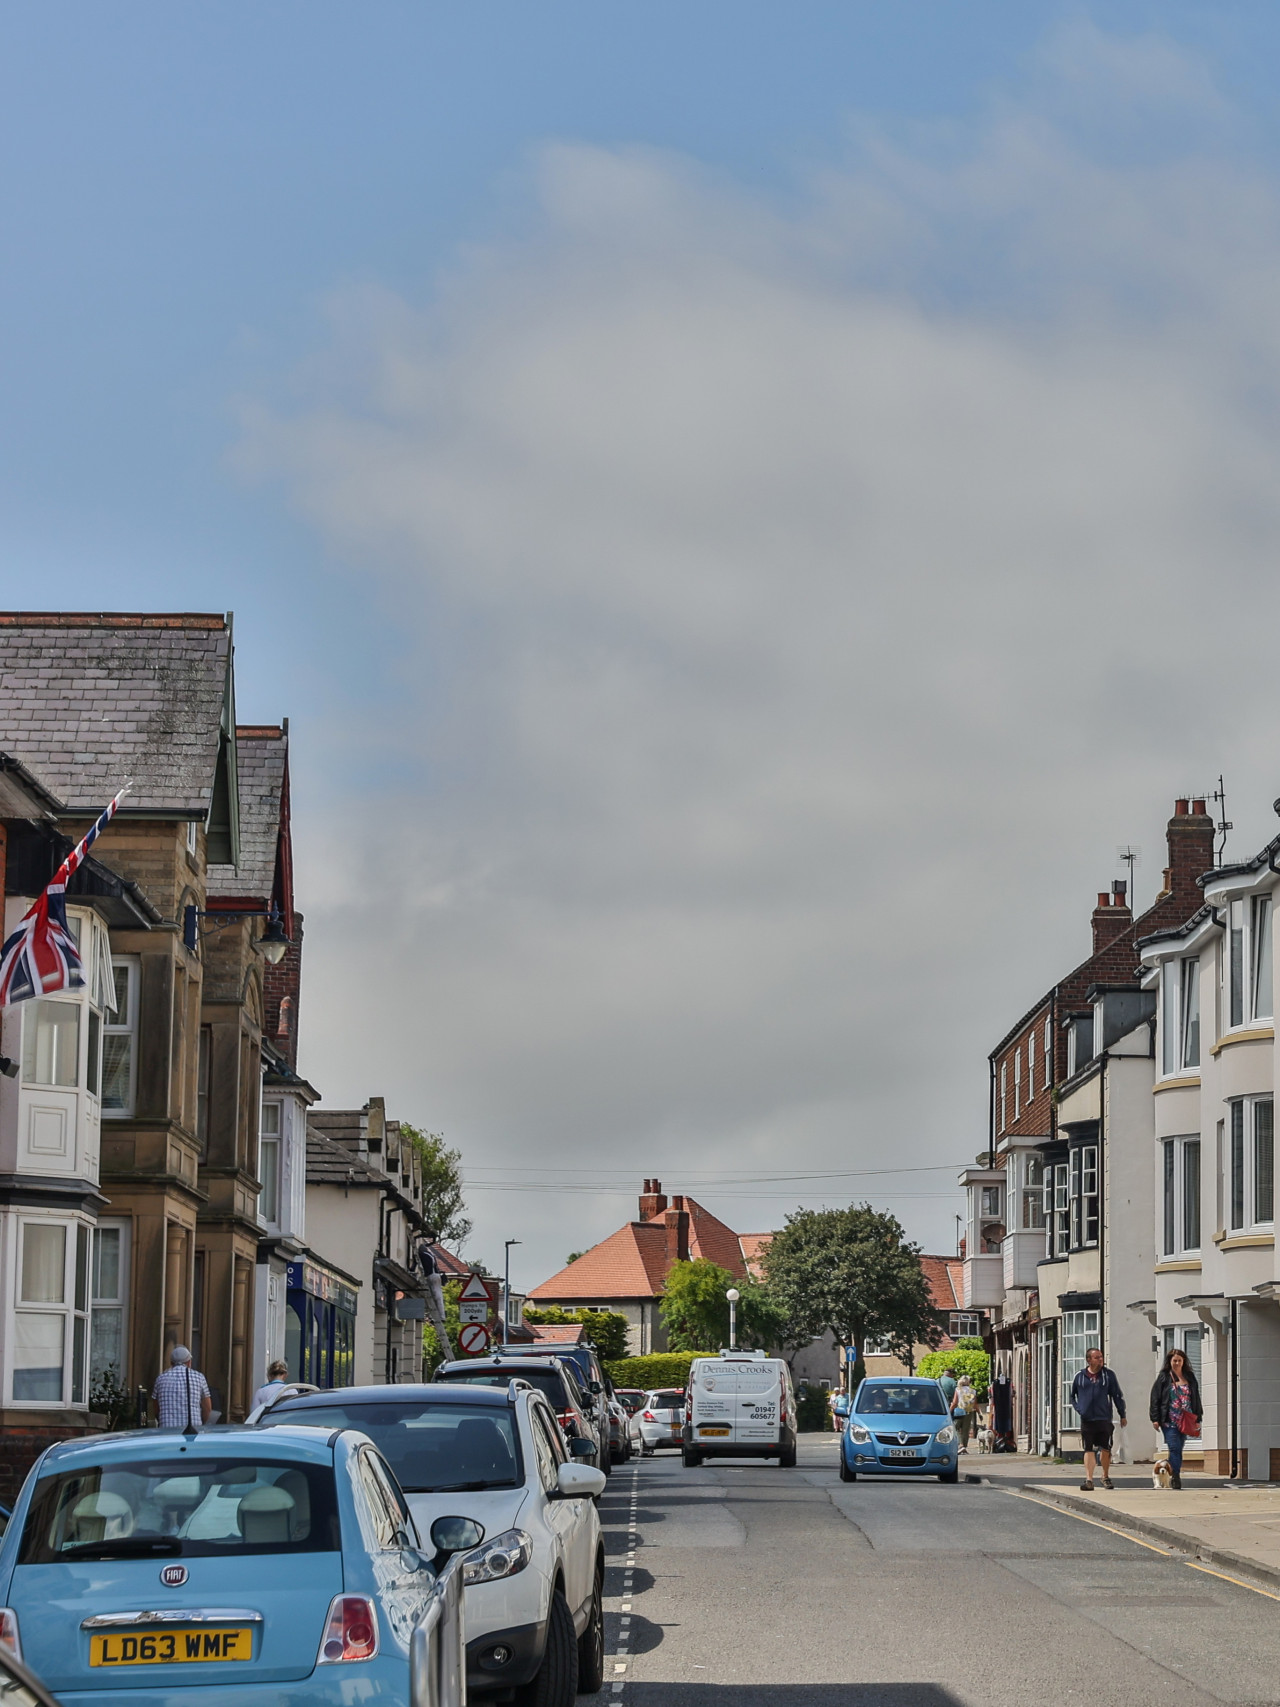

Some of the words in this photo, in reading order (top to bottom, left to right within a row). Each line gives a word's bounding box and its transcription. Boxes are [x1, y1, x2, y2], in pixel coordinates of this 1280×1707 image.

[703, 1365, 736, 1374] Dennis
[738, 1364, 773, 1374] Crooks
[166, 1569, 183, 1581] FIAT
[102, 1635, 176, 1663] LD63
[185, 1633, 240, 1658] WMF
